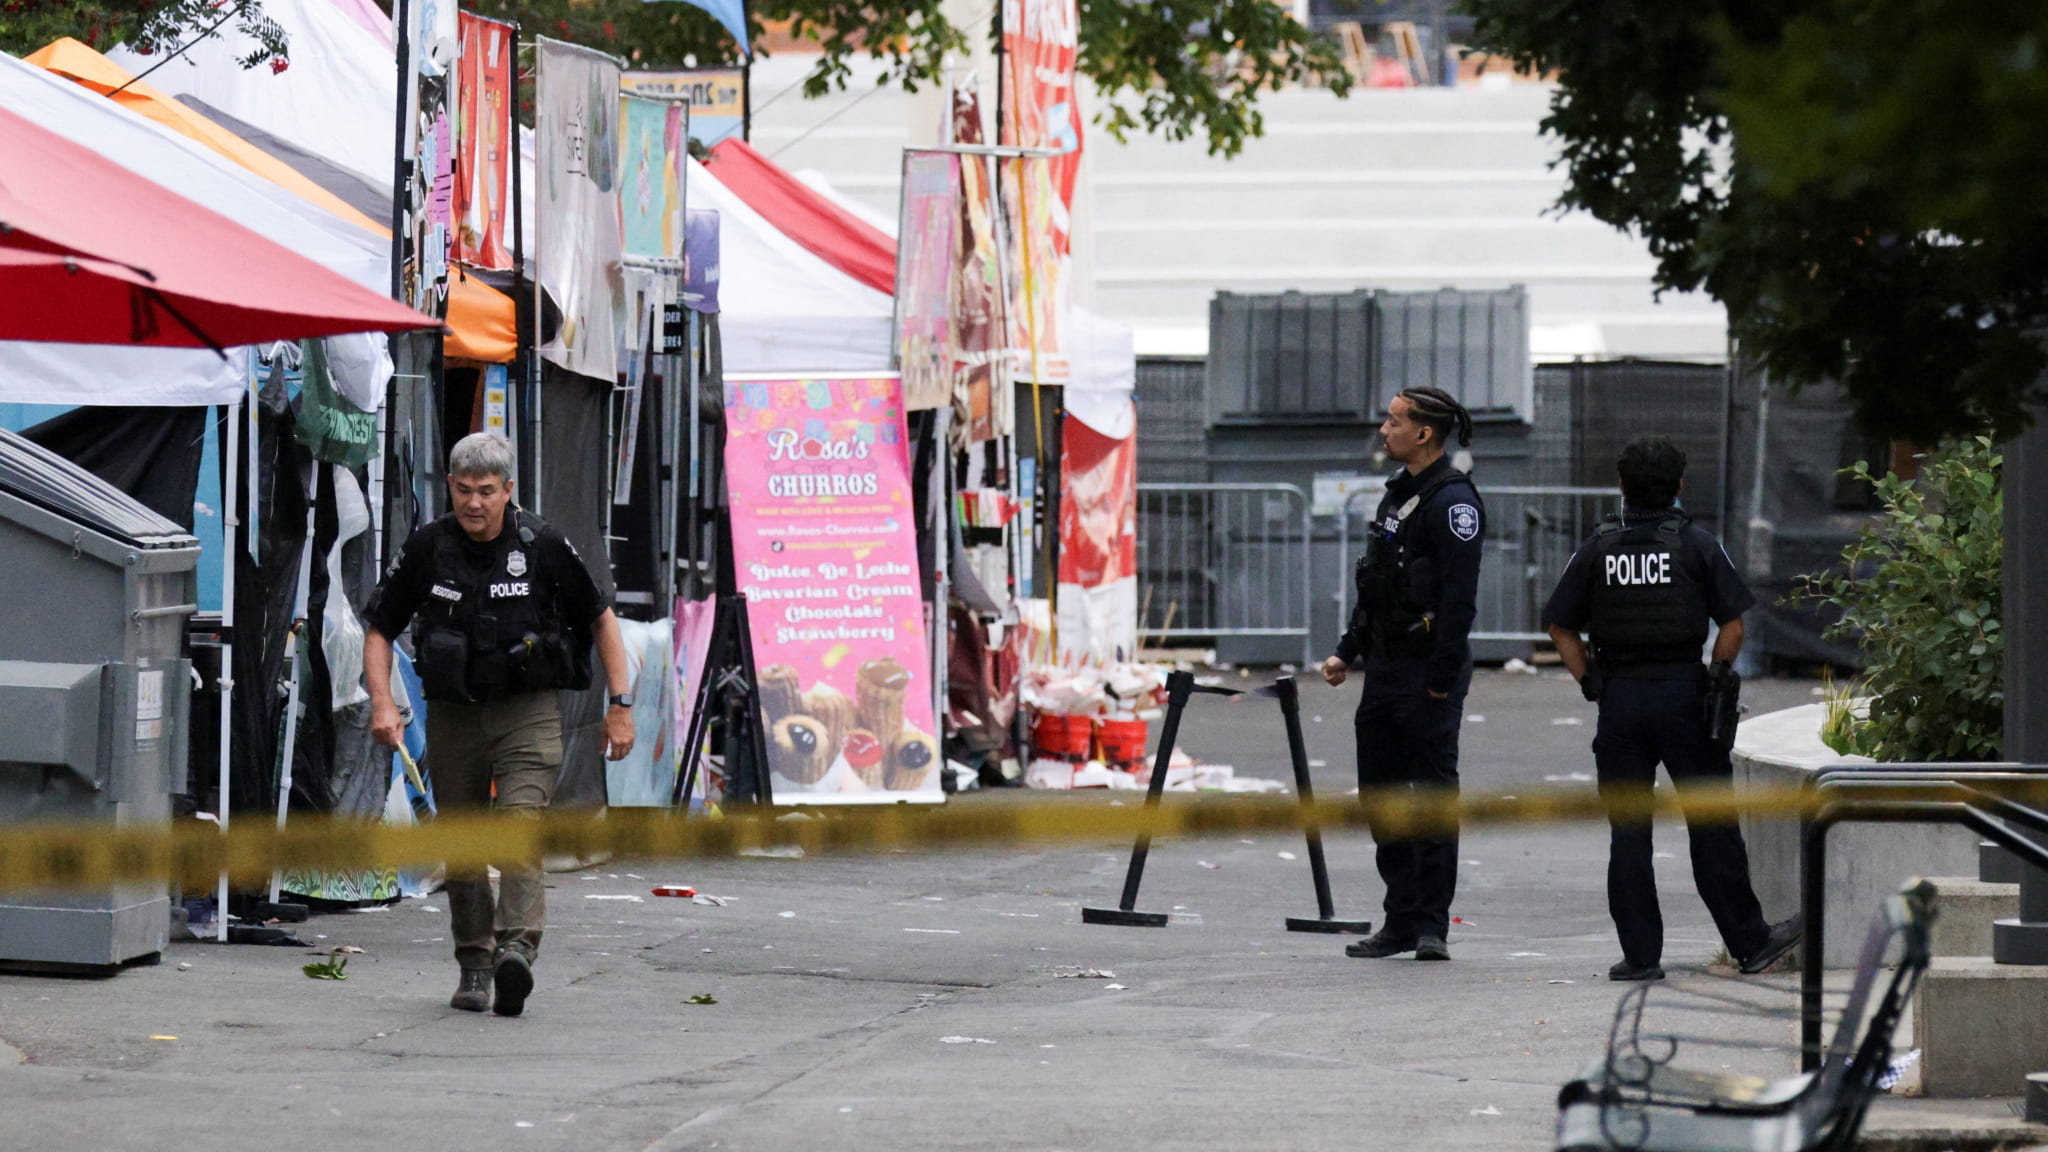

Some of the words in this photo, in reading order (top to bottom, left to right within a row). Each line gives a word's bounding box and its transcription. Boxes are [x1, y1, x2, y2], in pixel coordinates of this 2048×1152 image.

[767, 427, 870, 461] Rosa's
[768, 473, 879, 497] CHURROS
[1454, 507, 1474, 515] SEATTLE
[1384, 516, 1400, 533] POLICE
[1457, 527, 1473, 535] POLICE
[750, 564, 811, 581] Dulce
[818, 563, 849, 580] De
[856, 562, 911, 579] Leche
[1605, 552, 1671, 586] POLICE
[490, 582, 529, 598] POLICE
[743, 585, 838, 602] Bavarian
[847, 584, 913, 600] Cream
[785, 604, 883, 623] Chocolate
[777, 625, 895, 644] Strawberry
